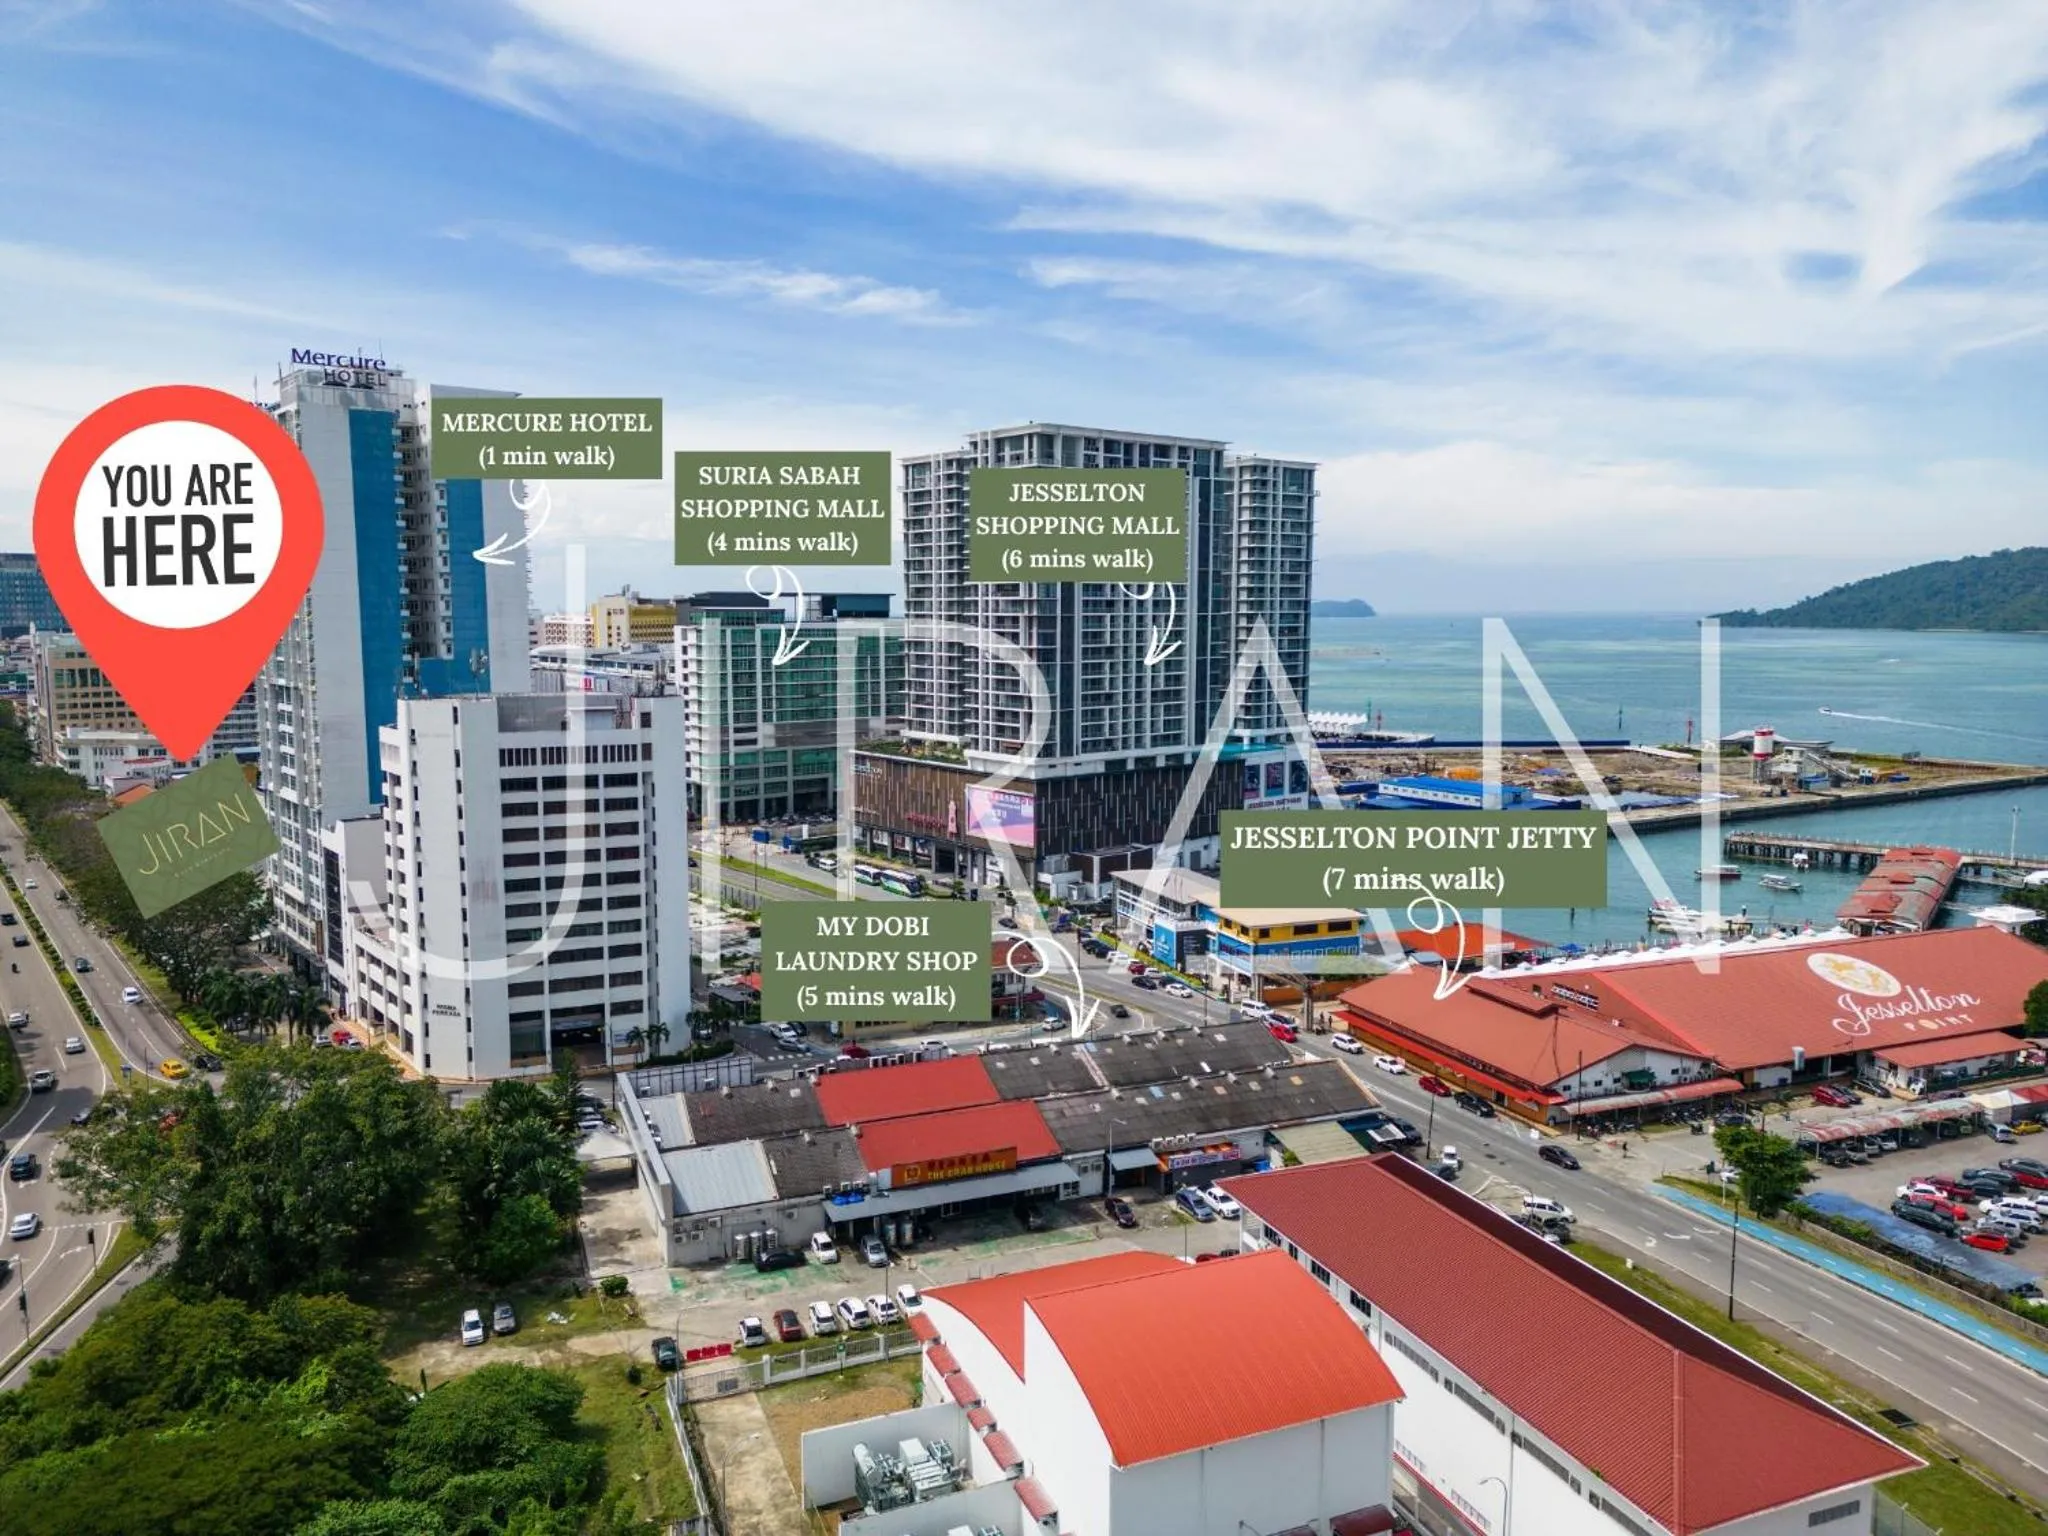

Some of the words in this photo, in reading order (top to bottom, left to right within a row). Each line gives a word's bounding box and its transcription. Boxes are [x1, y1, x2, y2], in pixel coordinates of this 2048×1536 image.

[291, 348, 386, 371] Mercure
[324, 368, 387, 386] HOTEL
[1832, 985, 1980, 1036] Jesselton
[1903, 1014, 1973, 1031] POINT
